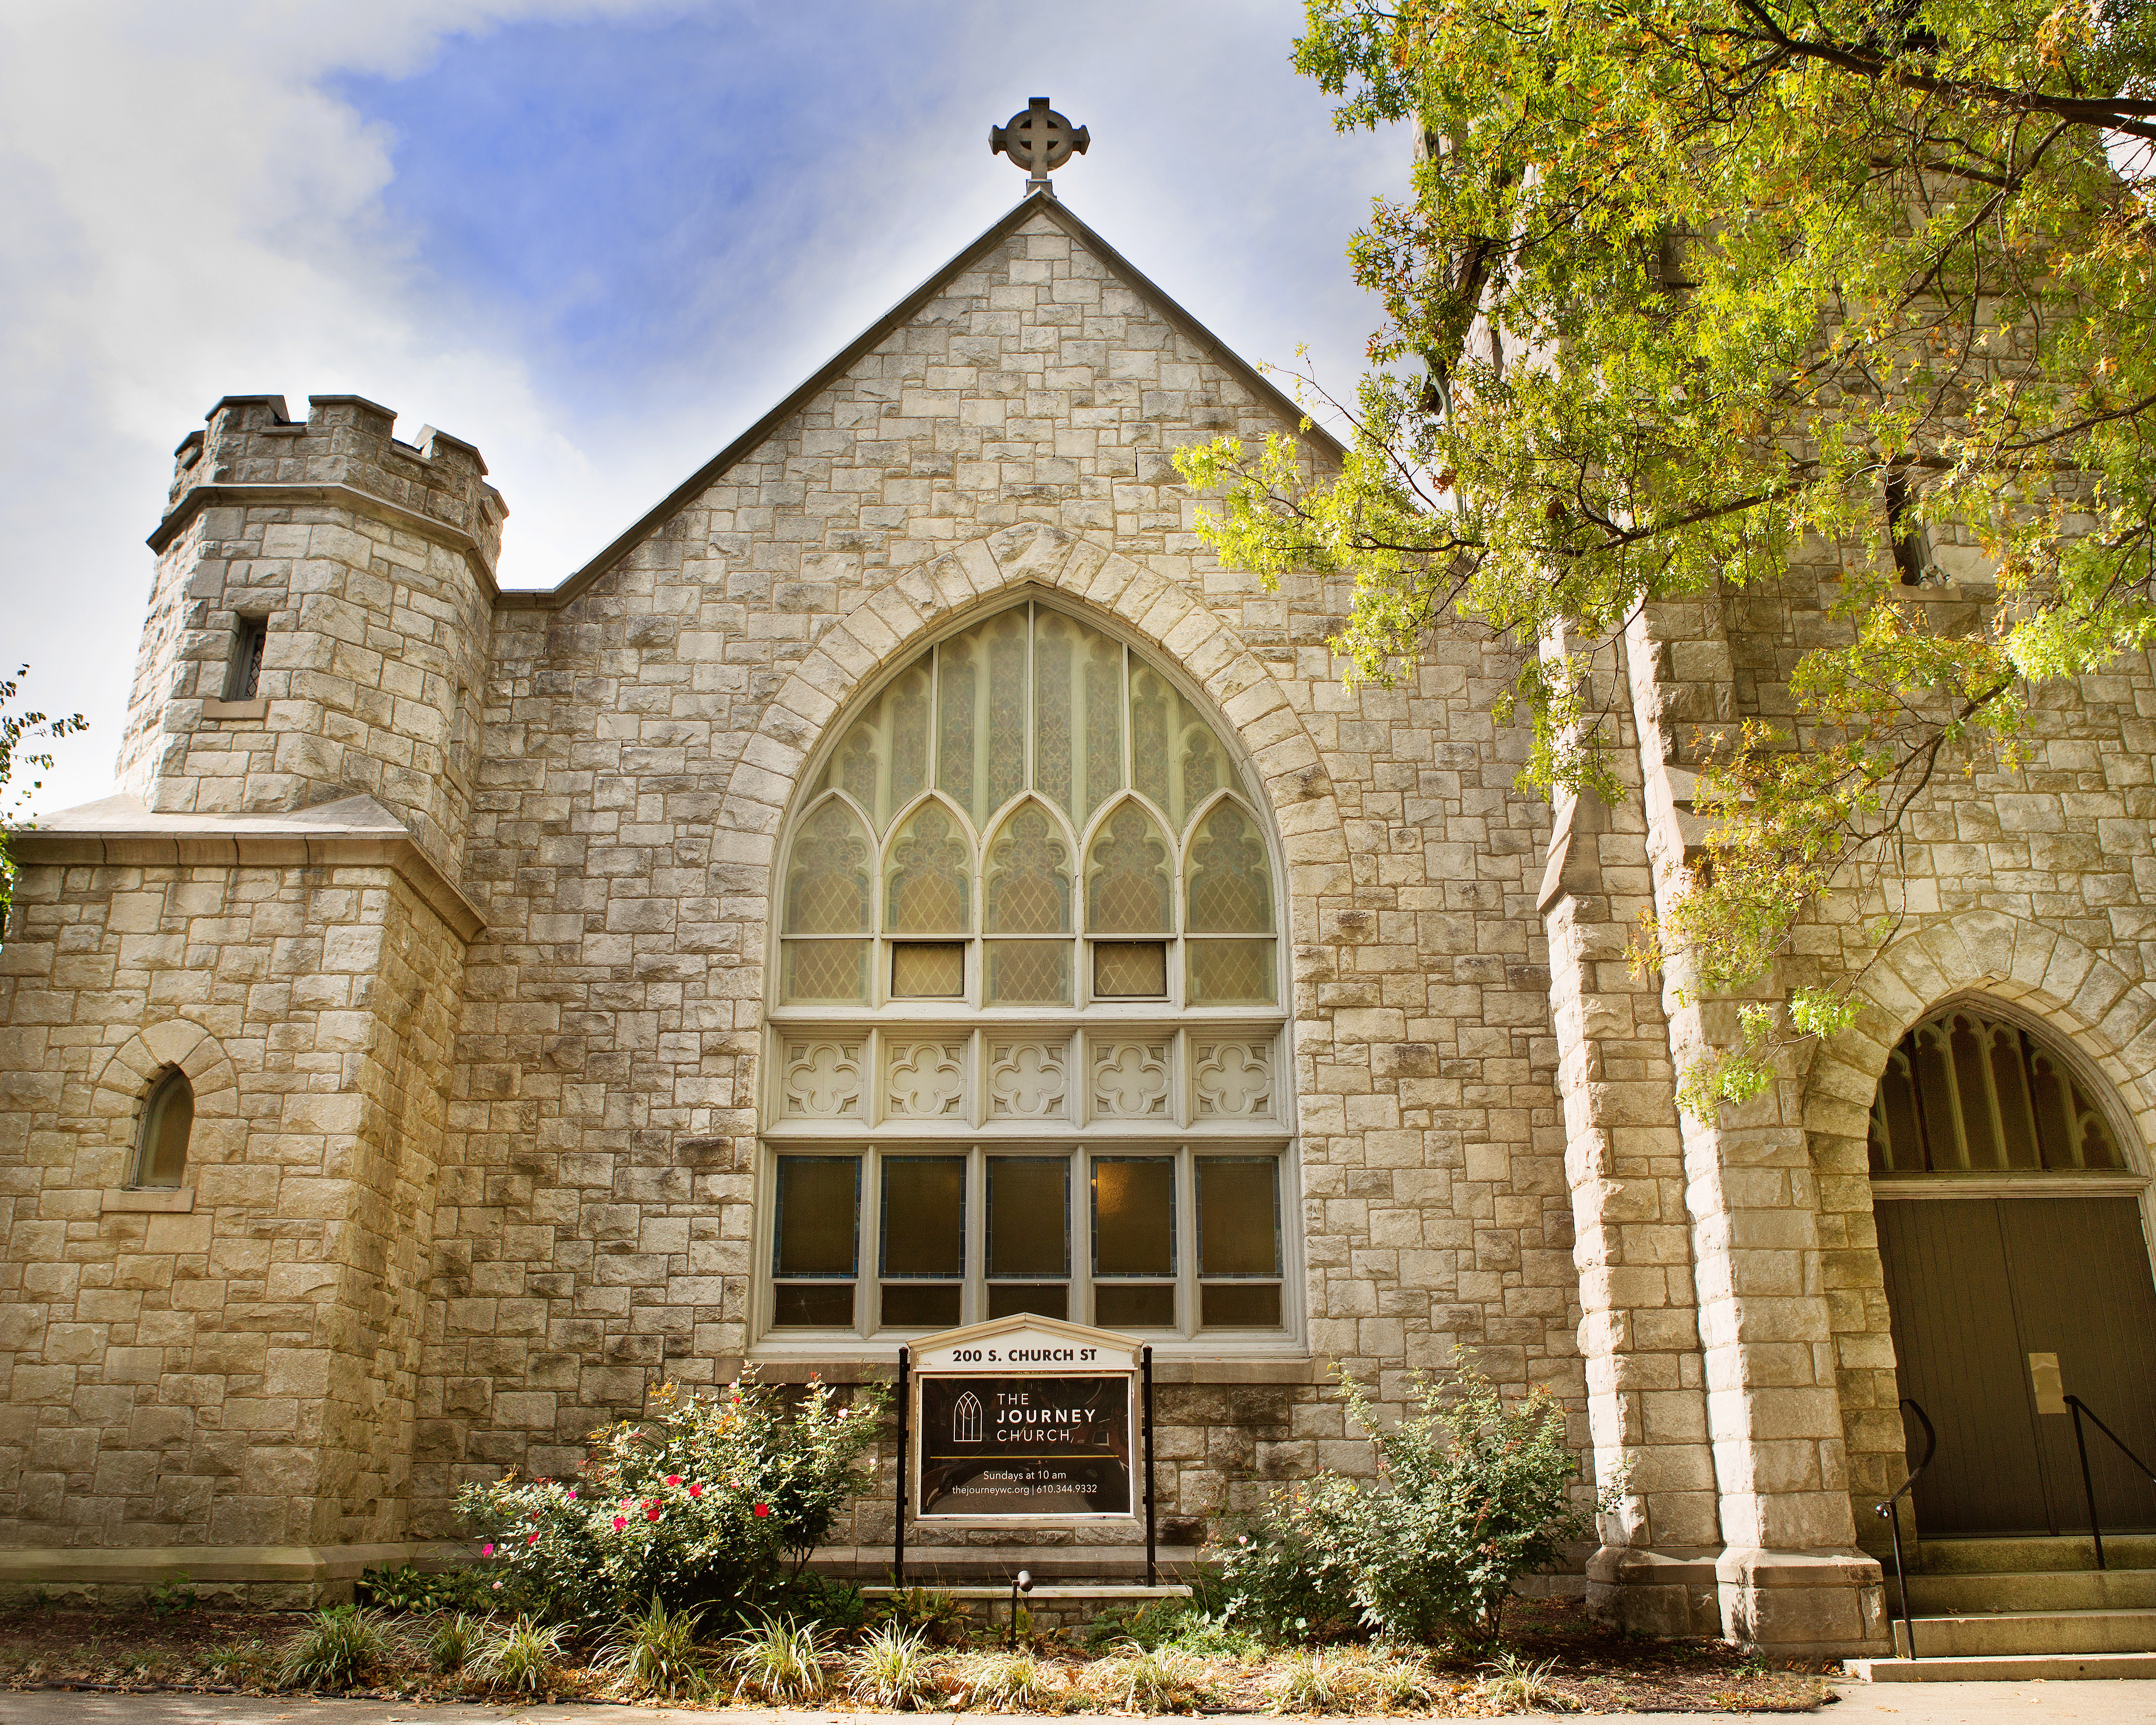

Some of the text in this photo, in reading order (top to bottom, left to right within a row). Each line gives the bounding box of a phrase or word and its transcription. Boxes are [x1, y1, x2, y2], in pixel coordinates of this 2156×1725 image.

[953, 1349, 1097, 1362] 200 S. CHURCH ST
[997, 1393, 1029, 1405] THE
[996, 1409, 1096, 1423] JOURNEY
[997, 1429, 1070, 1441] CHURCH
[983, 1471, 1023, 1482] Sundays
[1026, 1471, 1035, 1480] at
[1038, 1471, 1049, 1479] 10
[952, 1485, 1030, 1496] thejourneywc.org
[1036, 1484, 1097, 1493] 610.344.9332
